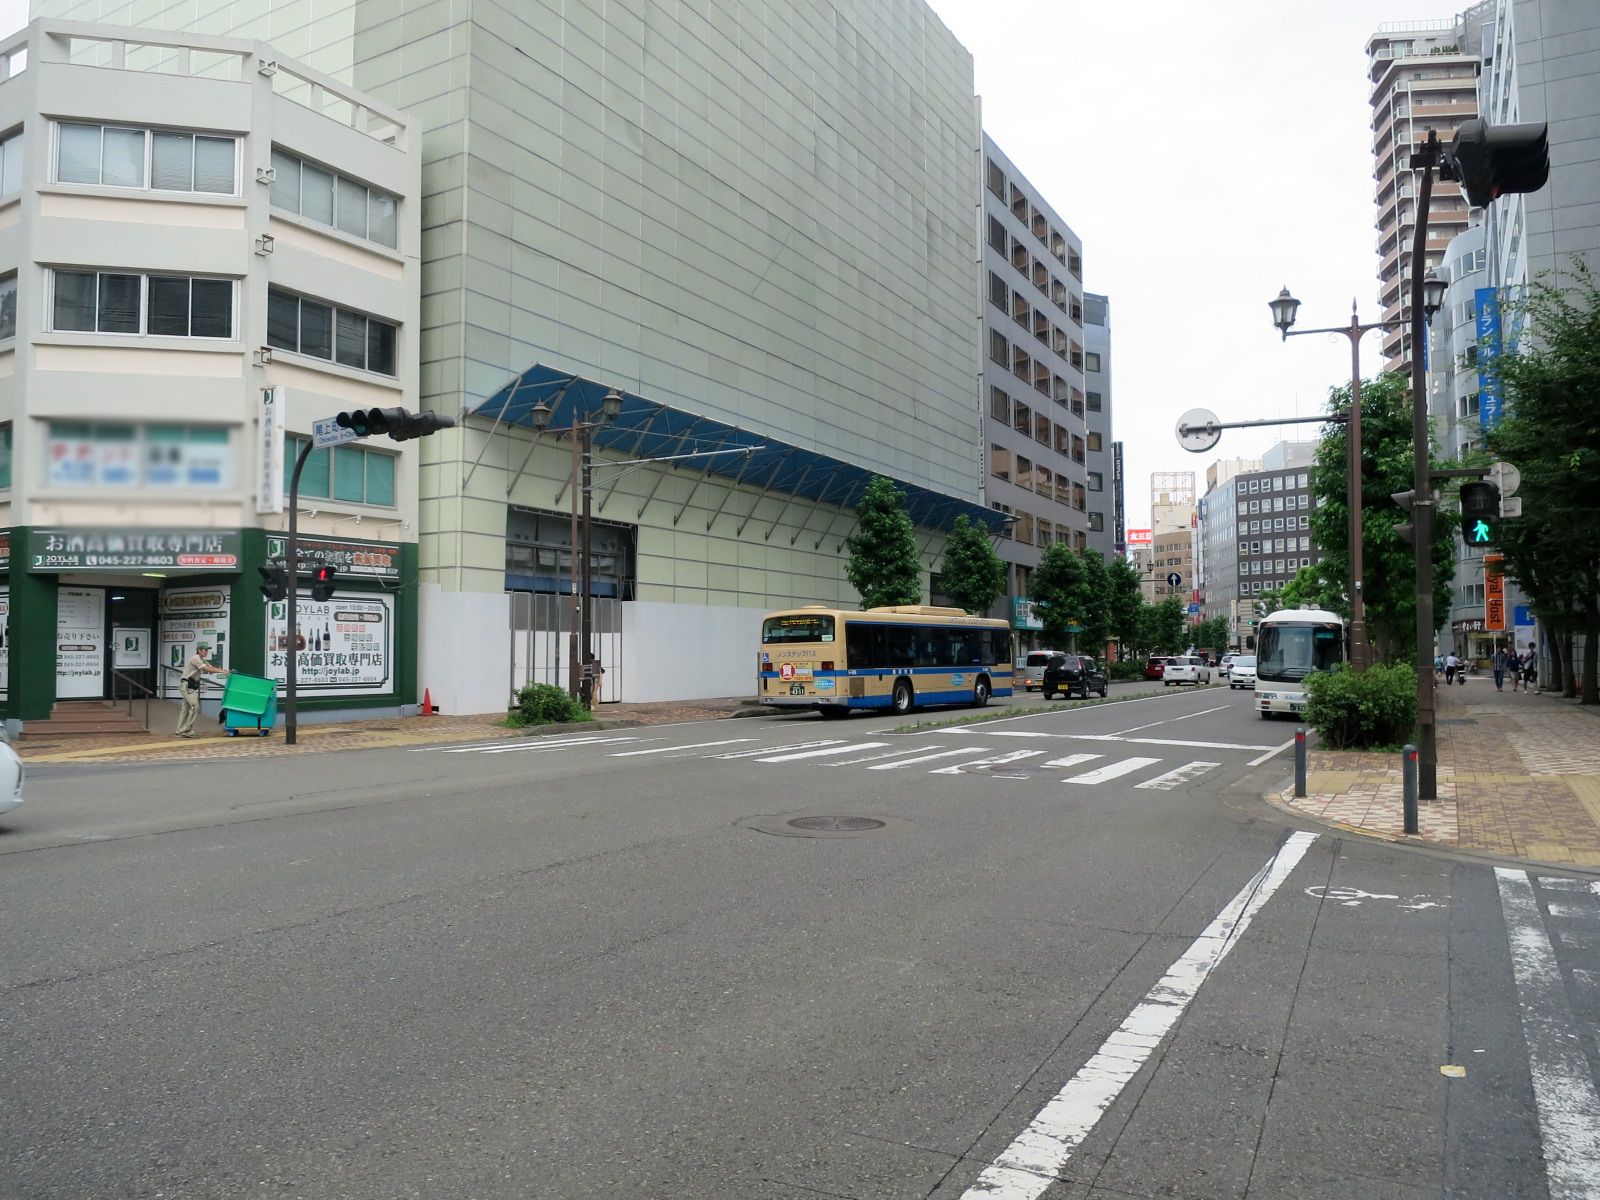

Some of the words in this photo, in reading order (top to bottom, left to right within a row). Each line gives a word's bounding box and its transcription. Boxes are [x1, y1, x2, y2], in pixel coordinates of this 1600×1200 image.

[1487, 561, 1502, 593] oyal
[295, 605, 330, 614] OYLAB
[302, 666, 360, 676] http://joylab.jp
